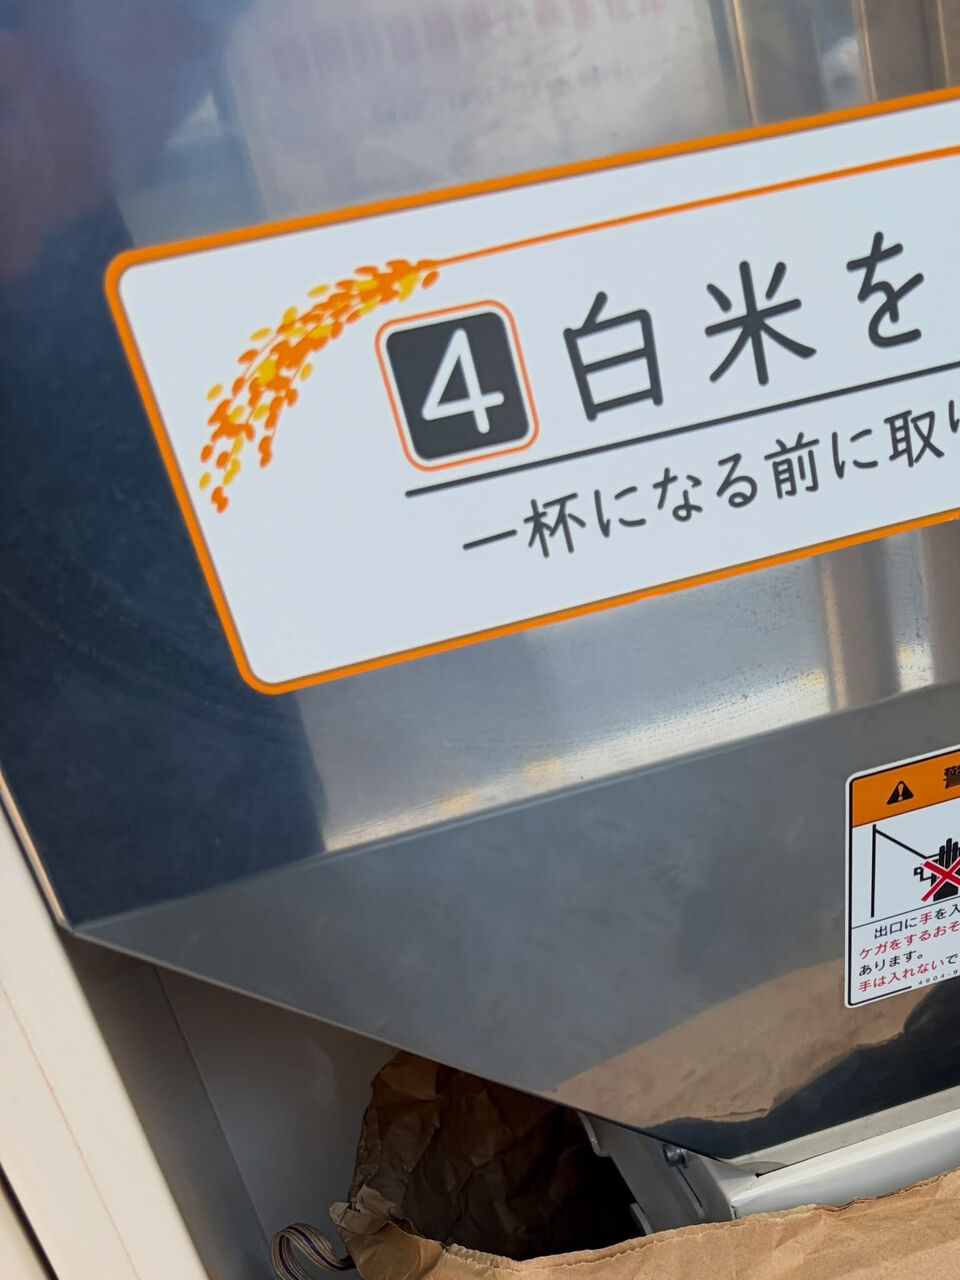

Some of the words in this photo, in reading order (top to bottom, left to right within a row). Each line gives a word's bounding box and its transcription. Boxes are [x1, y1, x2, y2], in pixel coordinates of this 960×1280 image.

[422, 327, 504, 433] 4
[858, 949, 924, 977] あります。
